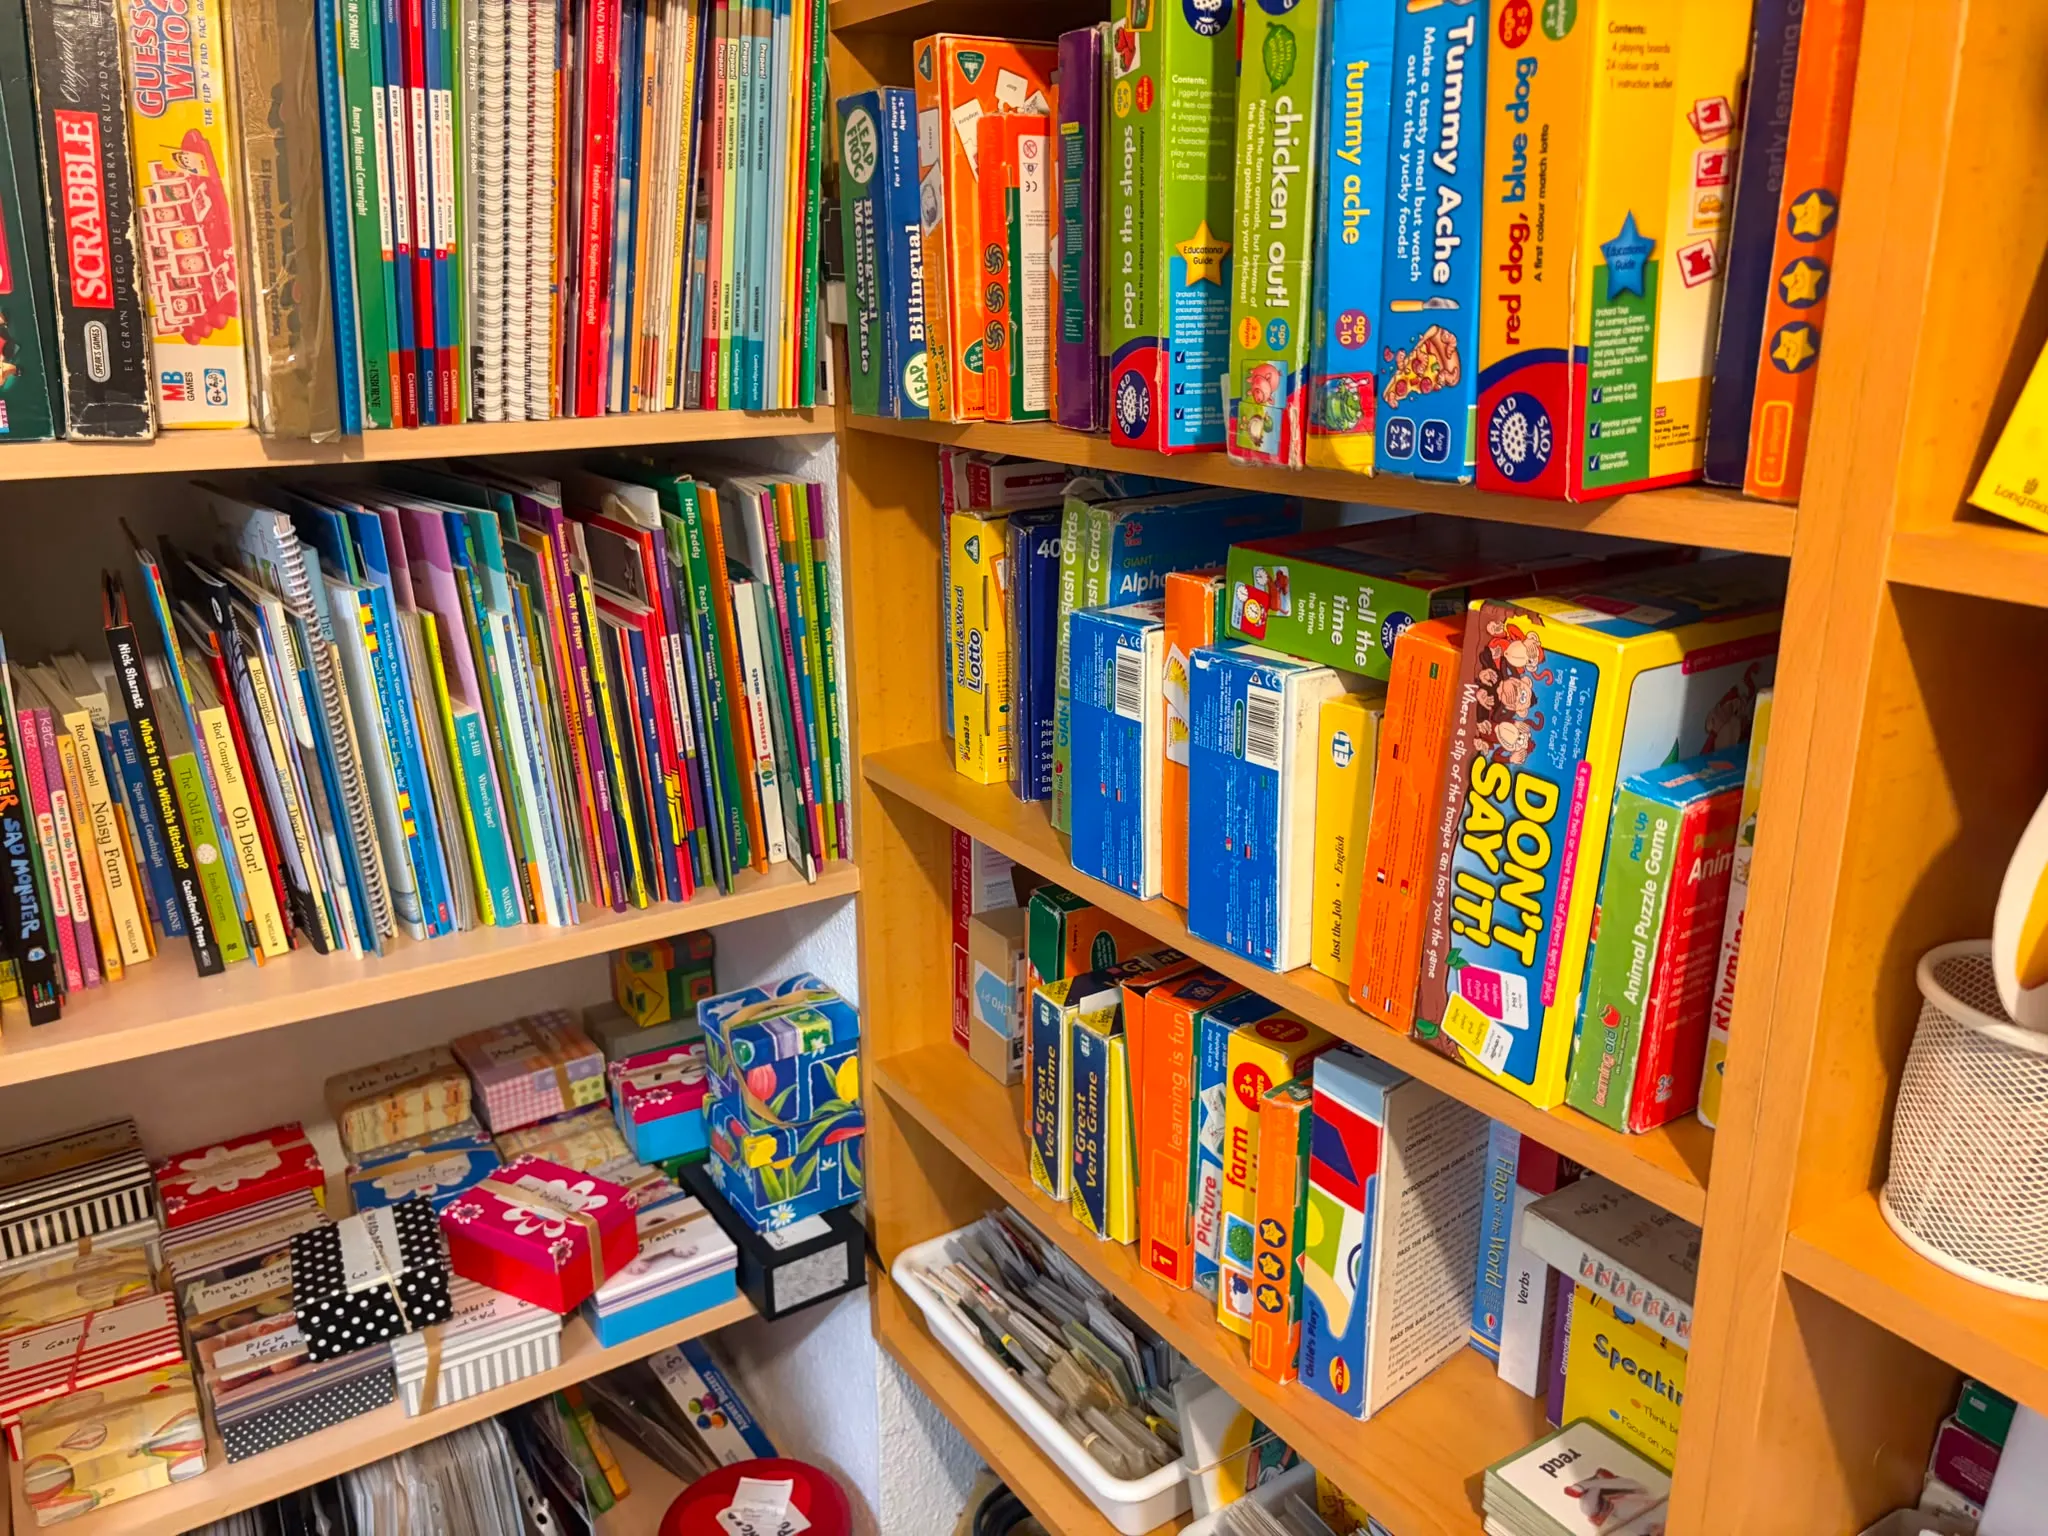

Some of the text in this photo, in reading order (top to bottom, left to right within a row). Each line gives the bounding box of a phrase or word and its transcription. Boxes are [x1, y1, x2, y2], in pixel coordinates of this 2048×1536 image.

[350, 13, 360, 49] SPANISH
[595, 25, 605, 64] WORDS
[1194, 19, 1221, 34] TOYS
[1608, 21, 1647, 34] Contents:
[131, 8, 165, 117] GUESS
[467, 20, 479, 91] FUN Flyers
[716, 44, 726, 80] Prepare!
[728, 44, 738, 80] Prepare!
[740, 41, 750, 77] Prepare!
[757, 44, 768, 79] Prepare!
[1172, 75, 1208, 85] Contents:
[97, 50, 120, 218] PALABRAS CRUZADAS
[890, 96, 898, 128] Players
[845, 128, 864, 178] FROG
[857, 117, 876, 167] LEAP
[1337, 61, 1370, 244] tummy ache
[1398, 55, 1417, 259] out for the yucky foods!
[1411, 27, 1436, 282] Make tasty meal but watch
[1433, 15, 1475, 283] Tummy Ache
[355, 154, 368, 215] and Cartwright
[1252, 158, 1263, 230] farm animals,
[1265, 96, 1301, 307] chicken out!
[1498, 56, 1538, 345] red dog, blue dog
[1538, 167, 1549, 198] match
[64, 120, 107, 300] SCRABBLE
[1119, 125, 1136, 329] pop to the shops
[586, 165, 602, 325] Heather Amery Stephen Cartwright
[862, 199, 878, 319] Bilingual
[1183, 245, 1223, 255] Educational
[1193, 257, 1213, 265] Guide
[853, 200, 871, 373] Memory Mate
[906, 224, 924, 341] Bilingual
[1240, 256, 1250, 303] chickens!
[1340, 314, 1352, 344] 3-10
[1354, 315, 1366, 343] age
[161, 371, 185, 400] MB
[185, 372, 194, 401] GAMES
[368, 369, 381, 408] USBORNE
[407, 373, 416, 415] CAMBRIDGE
[426, 370, 434, 412] CAMBRIDGE
[442, 371, 450, 412] CAMBRIDGE
[933, 361, 947, 412] Picture
[1116, 373, 1131, 434] ORCHARD
[1490, 396, 1516, 475] ORCHARD
[684, 498, 702, 559] Hello Teddy
[1056, 511, 1078, 747] GIANT Flash Cards
[1298, 598, 1306, 622] lotto
[1307, 592, 1316, 635] the time
[1318, 601, 1326, 631] Learn
[1331, 595, 1351, 646] time
[1355, 587, 1377, 667] tell the
[118, 643, 144, 709] Nick Sharratt
[383, 622, 414, 749] Ketchup Your Cornflakes?
[956, 642, 966, 687] Sound
[967, 628, 983, 693] Lotto
[252, 669, 275, 725] Rod Campbell
[39, 717, 54, 747] katz
[75, 724, 99, 788] Rod Campbell
[118, 729, 132, 747] Eric
[212, 721, 237, 784] Rod Campbell
[466, 722, 481, 757] Eric Hill
[137, 718, 189, 870] What's the Witch's Kitchen?
[186, 792, 201, 815] Odd
[477, 773, 495, 828] Where's Spot?
[1462, 756, 1511, 874] SAY
[92, 800, 123, 889] Noisy Farm
[141, 823, 164, 868] Goodnight
[232, 805, 261, 875] Oh Dear!
[731, 807, 743, 845] OXFORD
[1427, 683, 1478, 979] Where slip game
[1334, 835, 1346, 874] English
[1493, 772, 1559, 967] DON'T
[11, 859, 40, 939] MONSTER
[73, 883, 86, 917] Button?
[164, 897, 181, 932] WARNE
[181, 879, 202, 925] Candlewick
[500, 886, 514, 919] WARNE
[1453, 872, 1496, 948] IT!
[1552, 852, 1574, 947] more players
[1623, 818, 1668, 1005] Animal Puzzle Game
[1604, 1029, 1617, 1054] aid
[1036, 1066, 1047, 1123] Great
[1045, 1045, 1057, 1158] Verb Game
[1168, 1012, 1188, 1153] learning is fun
[1239, 1073, 1255, 1098] 3+
[1075, 1092, 1087, 1152] Great
[1085, 1071, 1098, 1188] Verb Game
[1226, 1126, 1249, 1189] farm
[1196, 1175, 1217, 1247] Picture
[1485, 1156, 1515, 1289] Flags World
[1517, 1269, 1531, 1306] Verbs
[244, 1334, 289, 1353] PICK
[1305, 1335, 1317, 1378] Child's
[1621, 1415, 1648, 1442] Focus
[1643, 1405, 1667, 1429] Think
[1538, 1446, 1583, 1479] read
